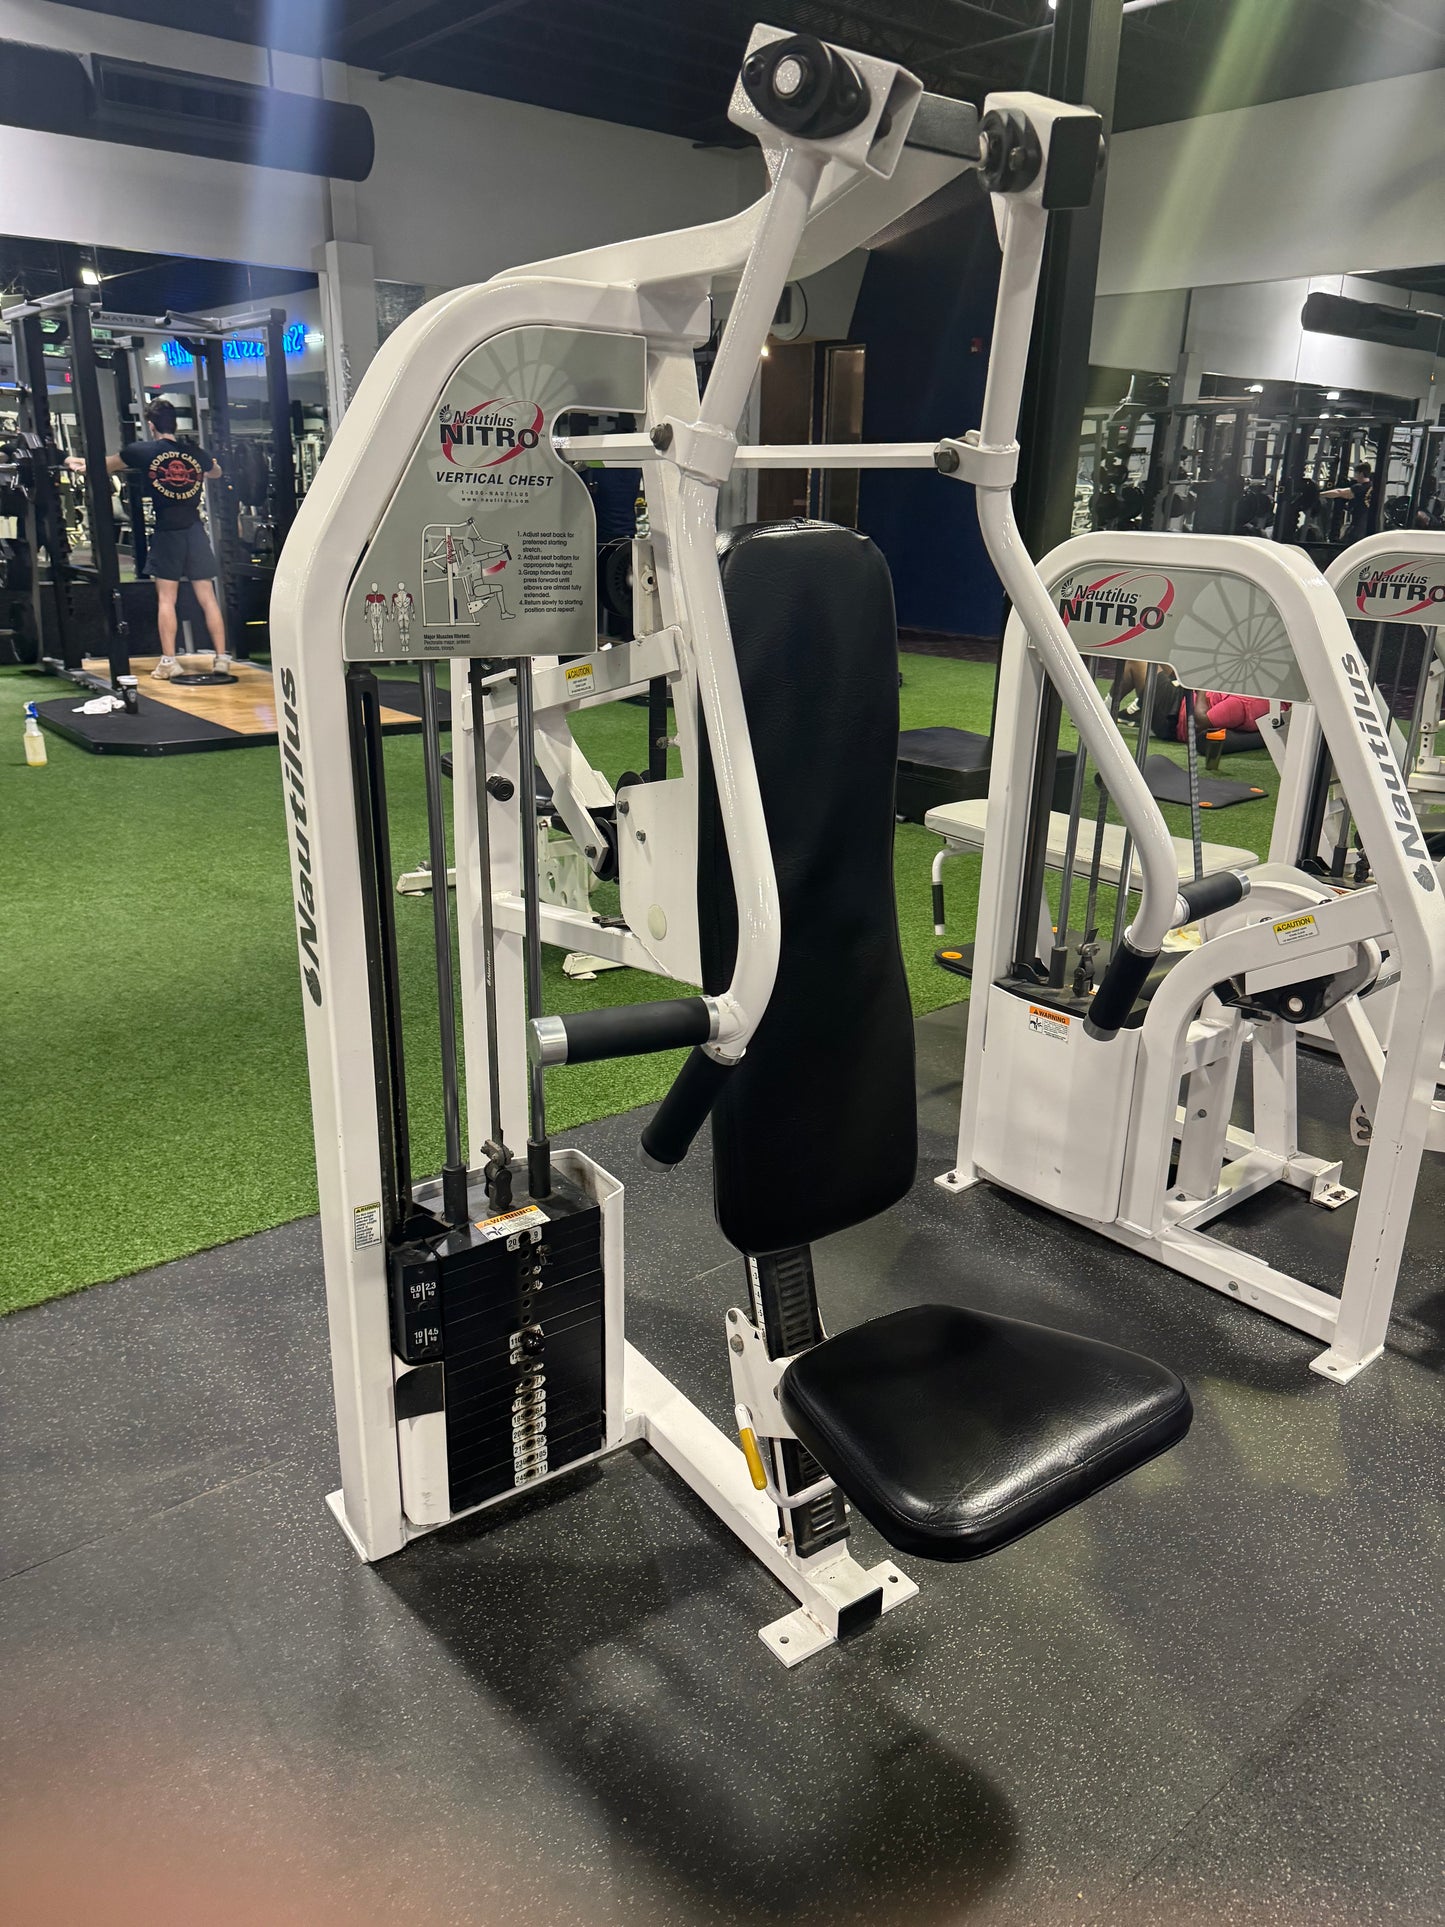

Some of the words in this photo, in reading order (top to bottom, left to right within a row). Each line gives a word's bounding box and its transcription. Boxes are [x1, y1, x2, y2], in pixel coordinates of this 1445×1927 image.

[102, 315, 145, 323] MATRIX
[453, 410, 515, 427] Nautilus
[440, 424, 539, 449] NITRO
[150, 451, 180, 471] NOBODY
[436, 471, 504, 485] VERTICAL
[508, 474, 554, 487] CHEST
[1370, 570, 1428, 584] Nautilus
[1074, 584, 1139, 604] Nautilus
[1356, 582, 1445, 602] NITRO
[1059, 598, 1165, 630] NITRO
[1341, 653, 1428, 861] Nautilus
[281, 667, 320, 972] Nautilus
[1281, 917, 1310, 930] CAUTION
[1039, 1010, 1066, 1024] WARNING
[489, 1207, 533, 1224] WARNING
[508, 1238, 517, 1248] 20
[534, 1230, 539, 1239] 9
[410, 1284, 421, 1294] 5.0
[425, 1282, 436, 1290] 2.3
[536, 1464, 547, 1474] 111
